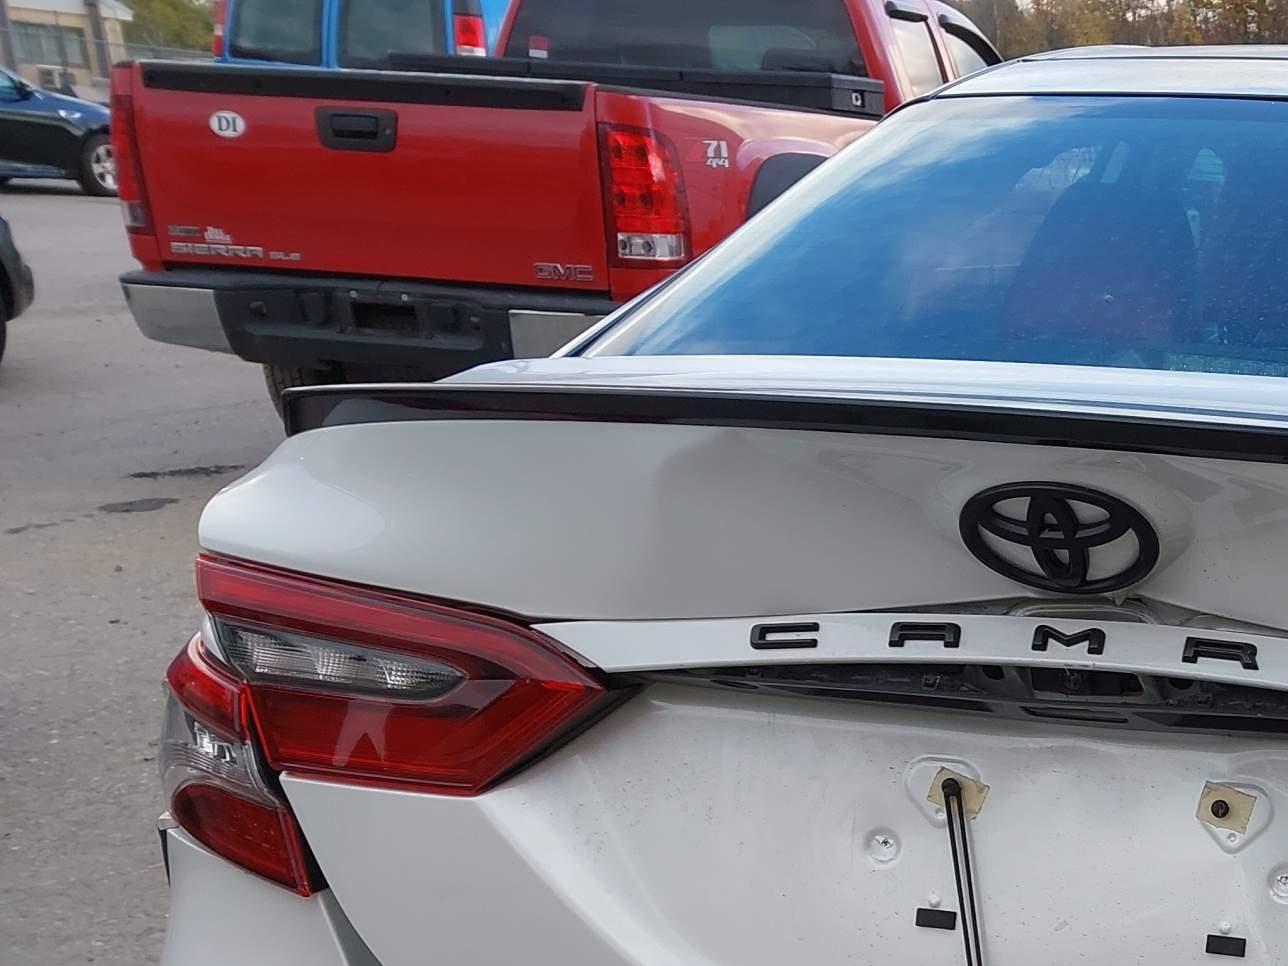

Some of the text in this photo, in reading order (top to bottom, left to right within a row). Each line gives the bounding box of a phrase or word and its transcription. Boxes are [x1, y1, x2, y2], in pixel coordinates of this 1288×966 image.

[215, 114, 239, 132] DI
[169, 241, 264, 258] SIERRA
[533, 262, 593, 281] GMC
